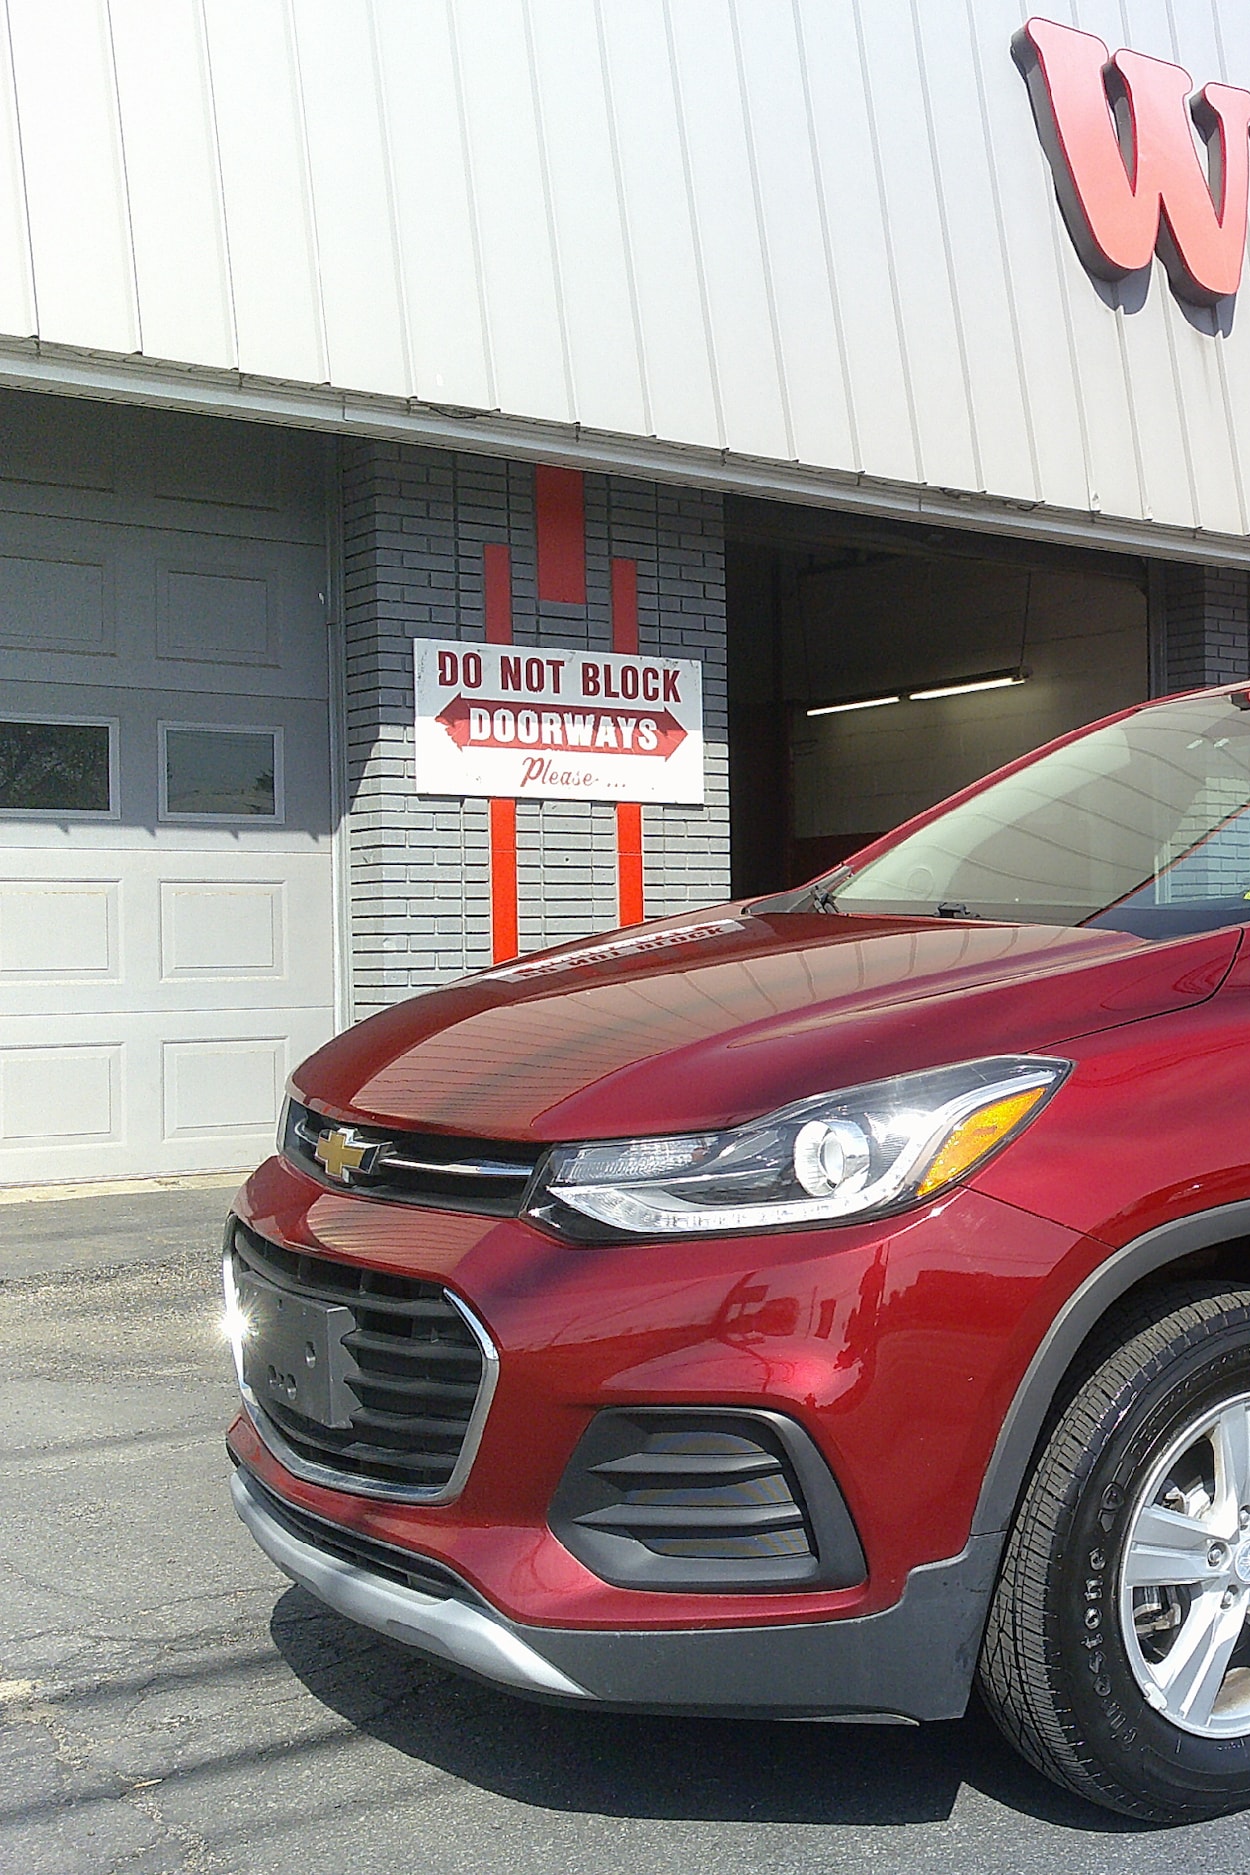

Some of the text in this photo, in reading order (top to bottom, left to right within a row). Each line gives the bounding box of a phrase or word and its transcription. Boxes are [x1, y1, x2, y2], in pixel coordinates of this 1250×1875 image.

[438, 651, 681, 703] DO NOT BLOCK
[469, 707, 658, 751] DOORWAYS
[519, 757, 594, 787] Please
